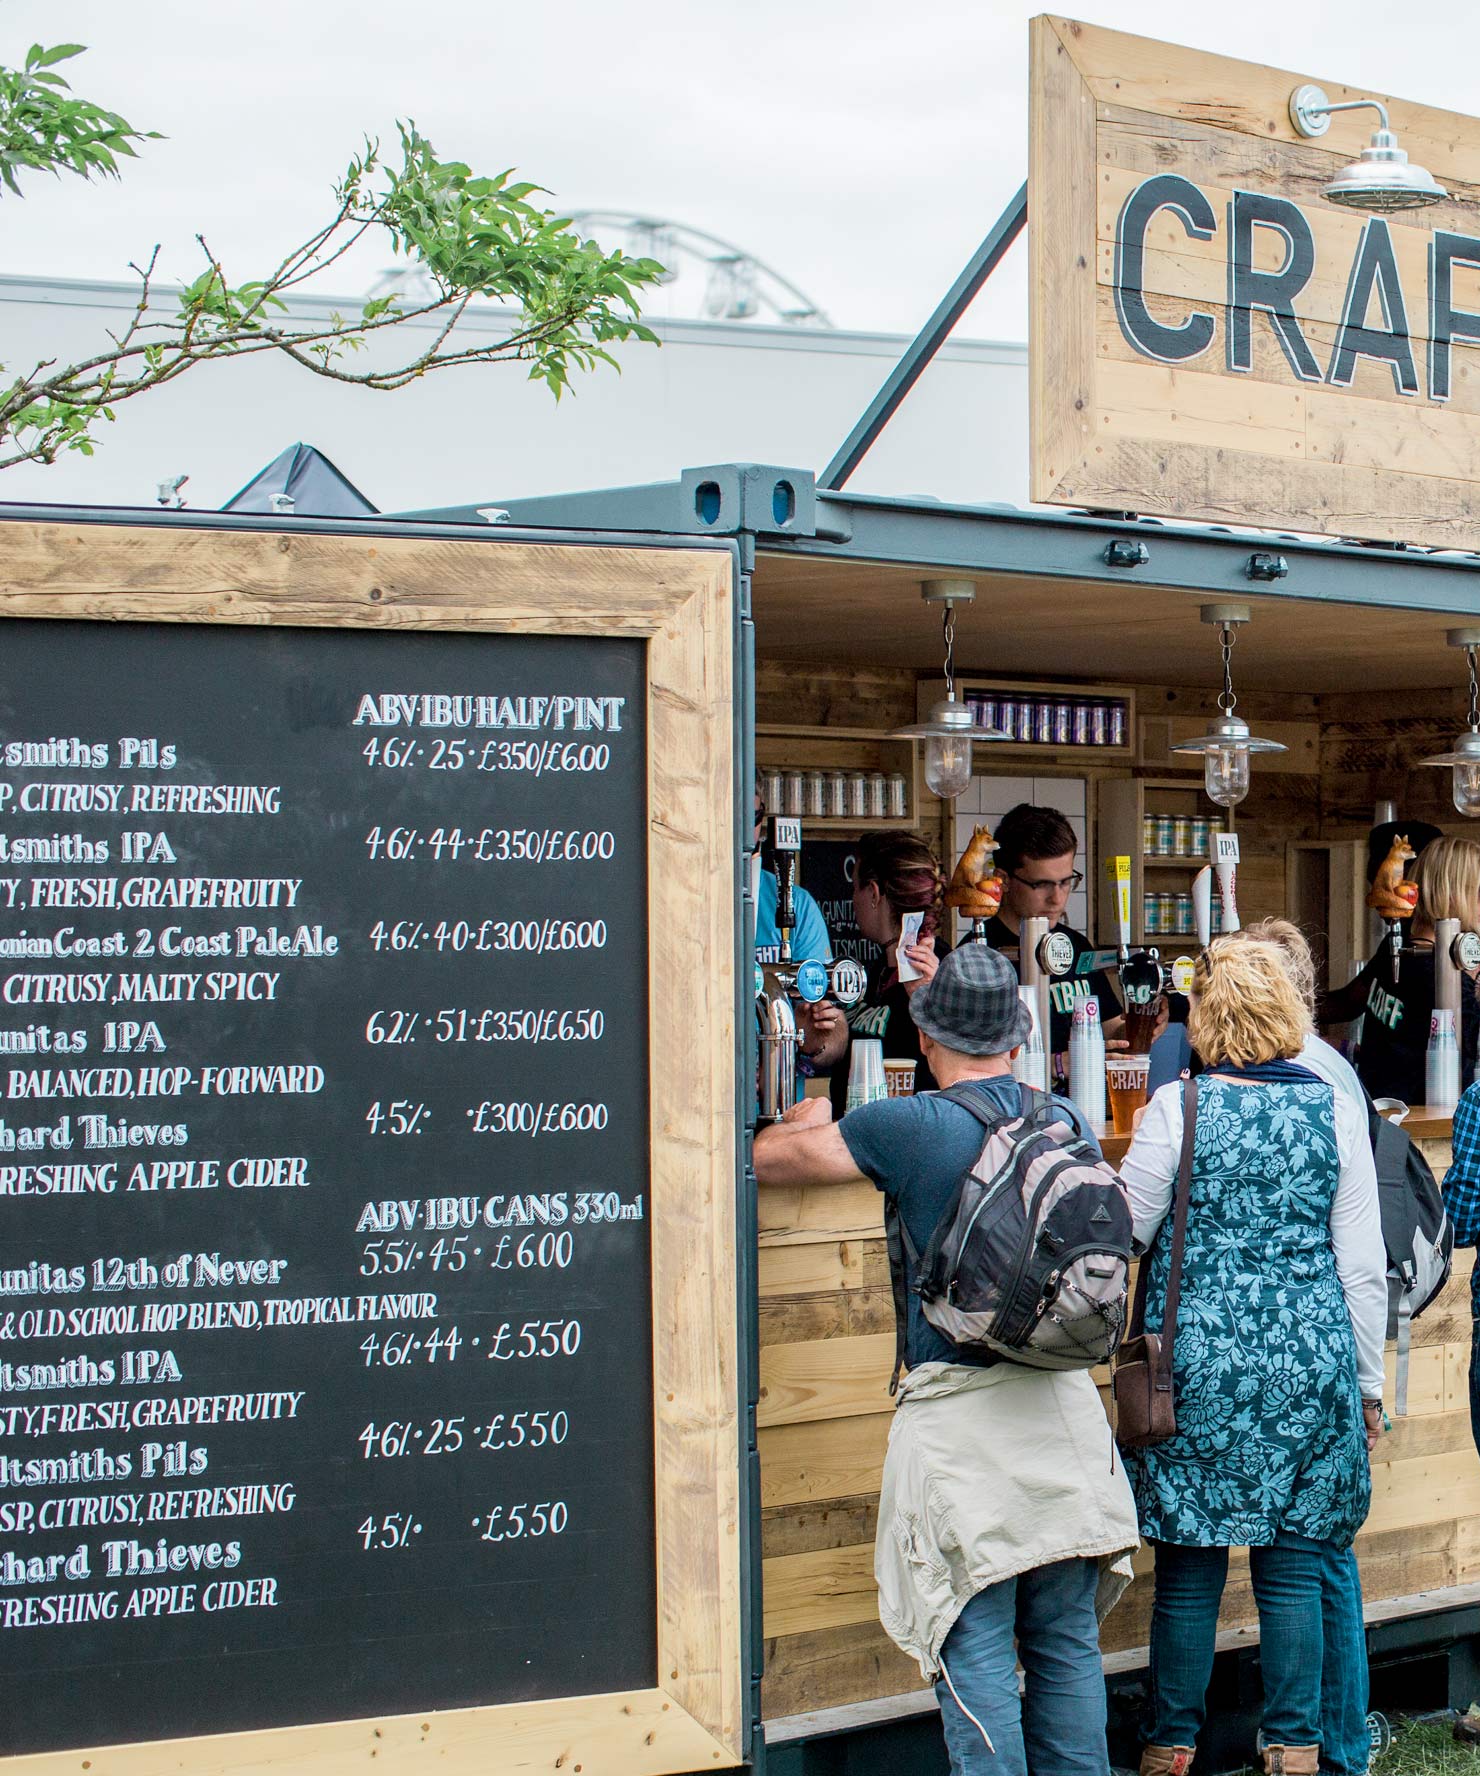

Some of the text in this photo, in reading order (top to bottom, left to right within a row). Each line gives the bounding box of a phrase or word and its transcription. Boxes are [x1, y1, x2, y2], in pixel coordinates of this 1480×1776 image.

[0, 737, 177, 769] smiths Pils
[120, 831, 177, 863] IPA
[777, 825, 800, 844] IPA
[1219, 840, 1238, 857] IPA
[133, 928, 154, 956] 2
[159, 926, 231, 956] Coast
[203, 972, 280, 1000] SPICY
[836, 971, 862, 993] IPA
[103, 1021, 166, 1052] IPA
[77, 1114, 188, 1149] Thieves
[126, 1160, 220, 1192] APPLE
[227, 1157, 310, 1188] CIDER
[572, 1191, 643, 1223] 330ml
[91, 1257, 158, 1291] 12th
[161, 1254, 193, 1288] of
[193, 1252, 288, 1287] Never
[19, 1308, 66, 1338] OLD
[65, 1306, 140, 1337] SCHOOL
[144, 1304, 187, 1333] HOP
[264, 1297, 353, 1326] TROPICAL
[356, 1293, 438, 1320] FLAVOUR
[0, 1350, 183, 1392] tsmiths IPA
[141, 1440, 208, 1478] Pils
[102, 1539, 241, 1577] Thieves
[0, 1577, 279, 1628] RESHING APPLE CIDER
